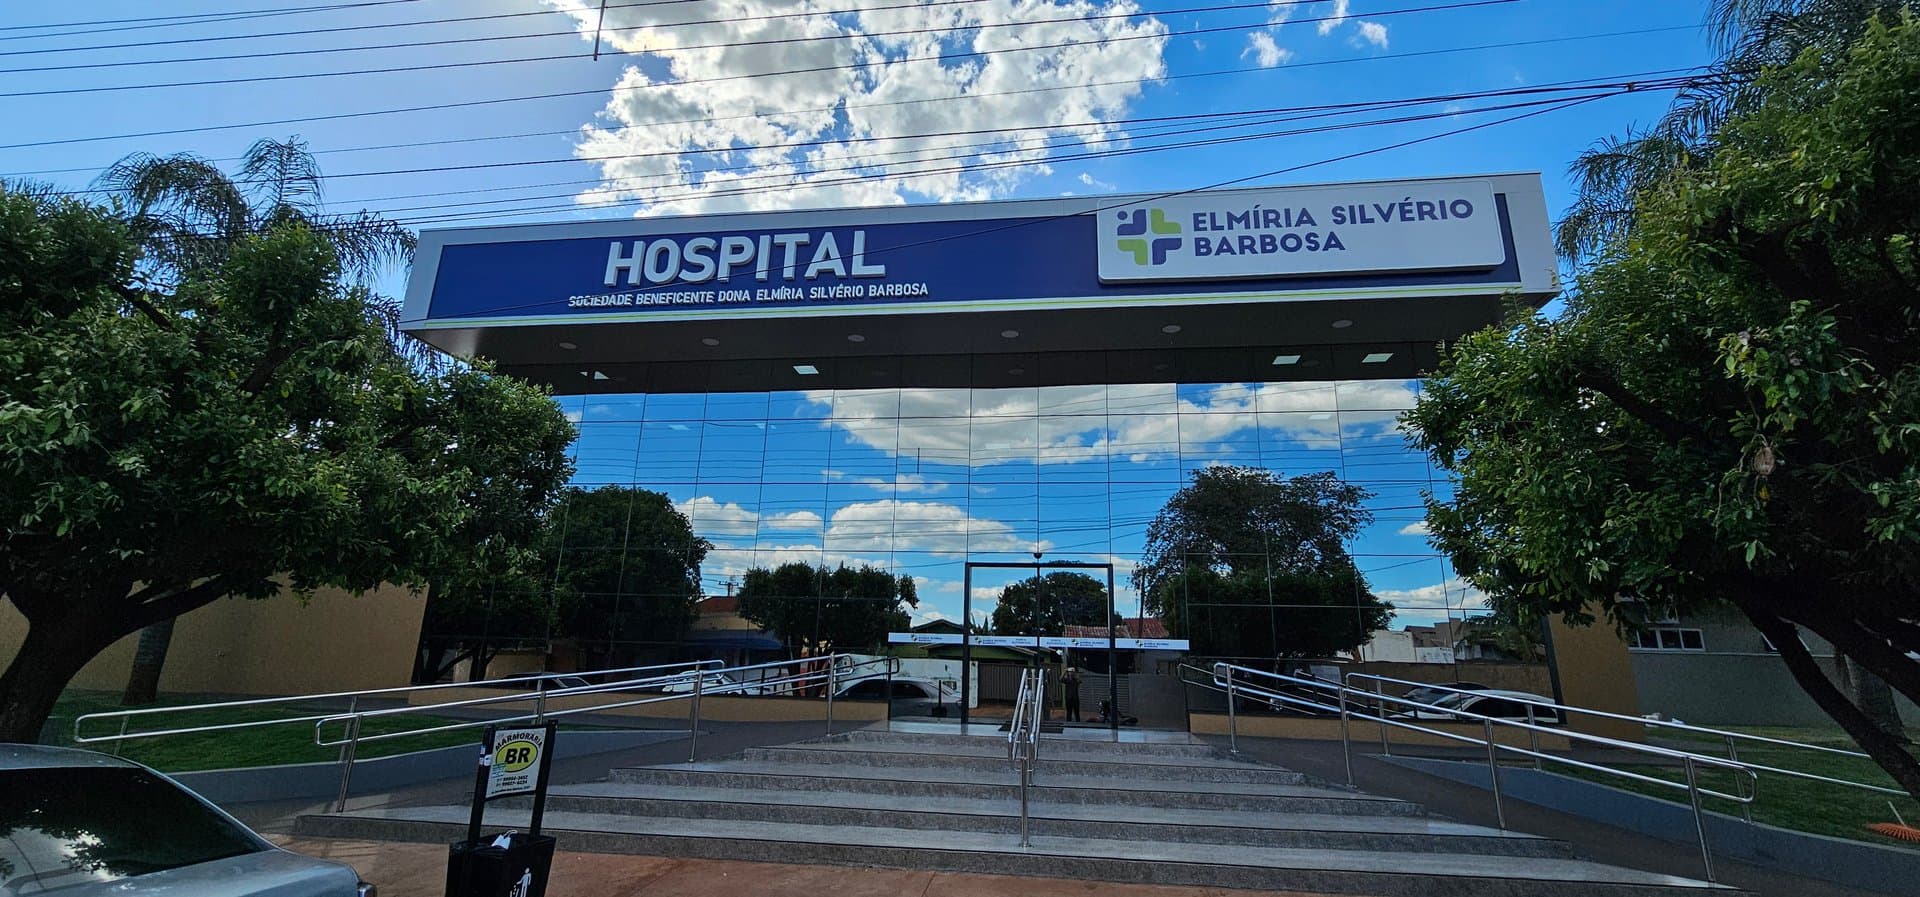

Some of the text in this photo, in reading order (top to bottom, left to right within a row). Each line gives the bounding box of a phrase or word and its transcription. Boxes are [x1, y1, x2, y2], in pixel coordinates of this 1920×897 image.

[1193, 196, 1474, 232] ELMÍRIA SILVÉRIO
[1194, 232, 1346, 257] BARBOSA
[604, 230, 886, 286] HOSPITAL
[568, 282, 929, 308] SOCIEDADE BENEFICENTE DONA ELMÍRIA SILVÉRIO BARBOSA
[505, 747, 530, 764] BR
